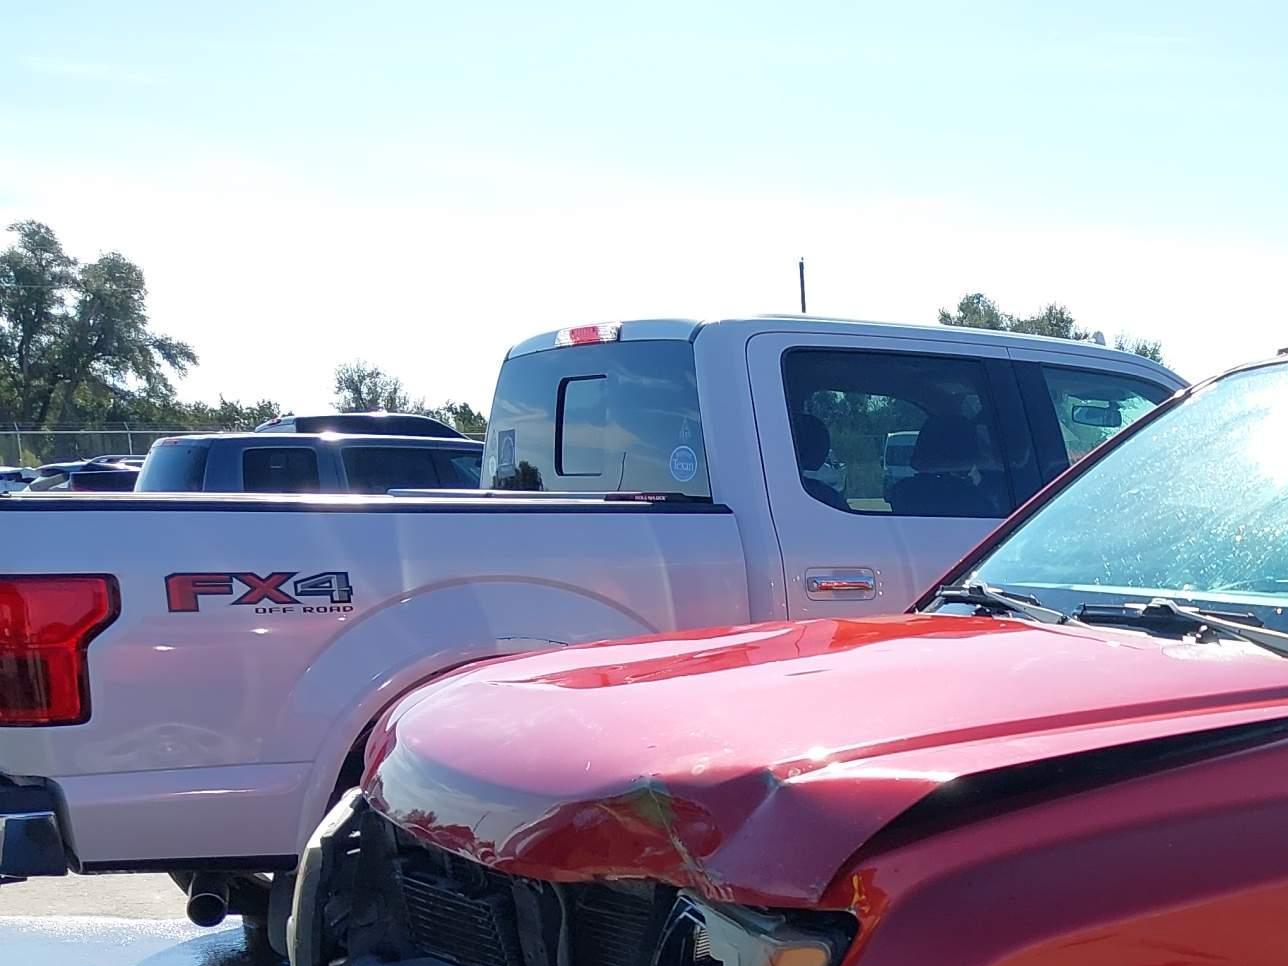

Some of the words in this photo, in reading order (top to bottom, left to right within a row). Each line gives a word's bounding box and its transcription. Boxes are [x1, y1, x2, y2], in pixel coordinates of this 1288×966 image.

[164, 571, 354, 613] FX4
[255, 606, 295, 614] OFF
[302, 605, 354, 614] ROAD
